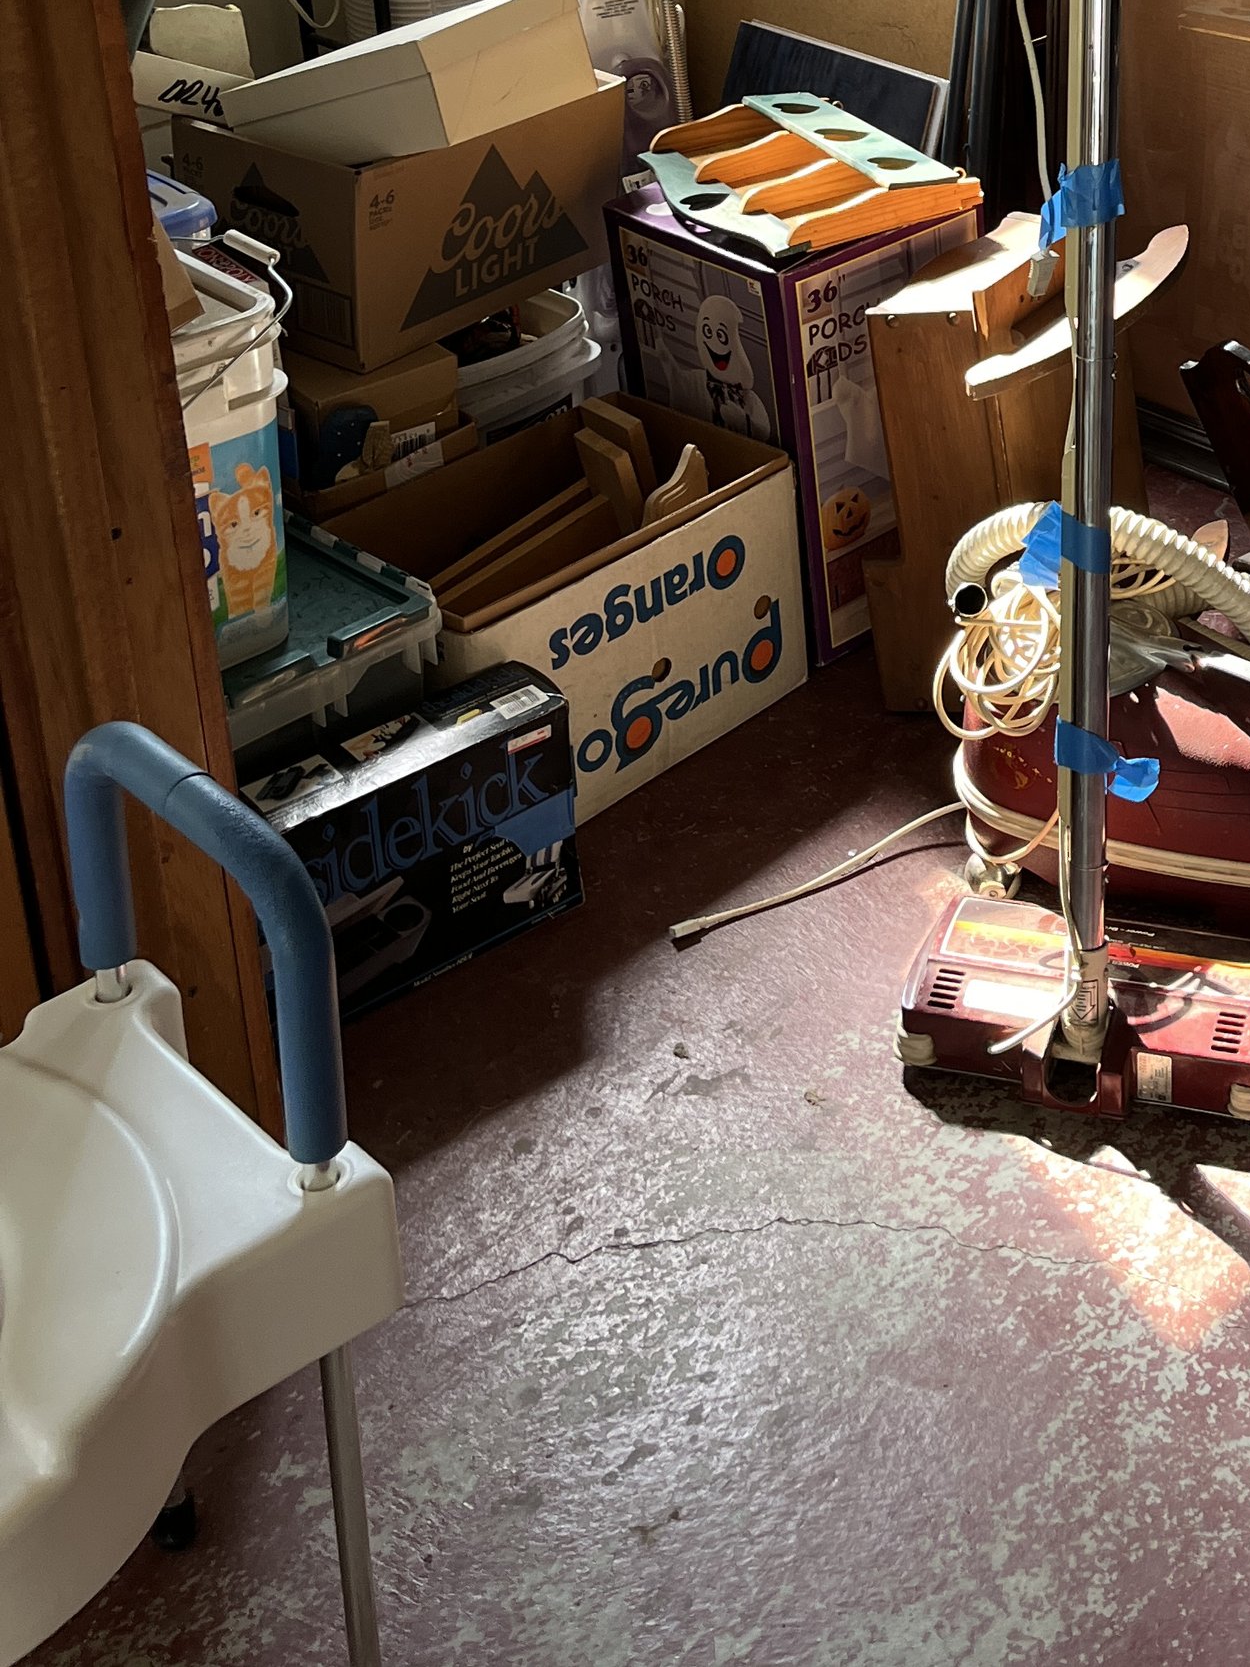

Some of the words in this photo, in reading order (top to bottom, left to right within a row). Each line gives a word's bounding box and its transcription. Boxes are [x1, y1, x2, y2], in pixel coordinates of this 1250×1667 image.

[368, 189, 395, 209] 4-6
[429, 194, 564, 274] Coors
[194, 244, 259, 285] ONOPOLY
[454, 237, 539, 299] LIGHT
[631, 274, 685, 313] PORCH
[806, 274, 848, 315] 36"
[634, 299, 677, 333] KIDS
[810, 334, 868, 373] KIDS
[549, 534, 746, 671] Oranges
[576, 597, 783, 775] purego
